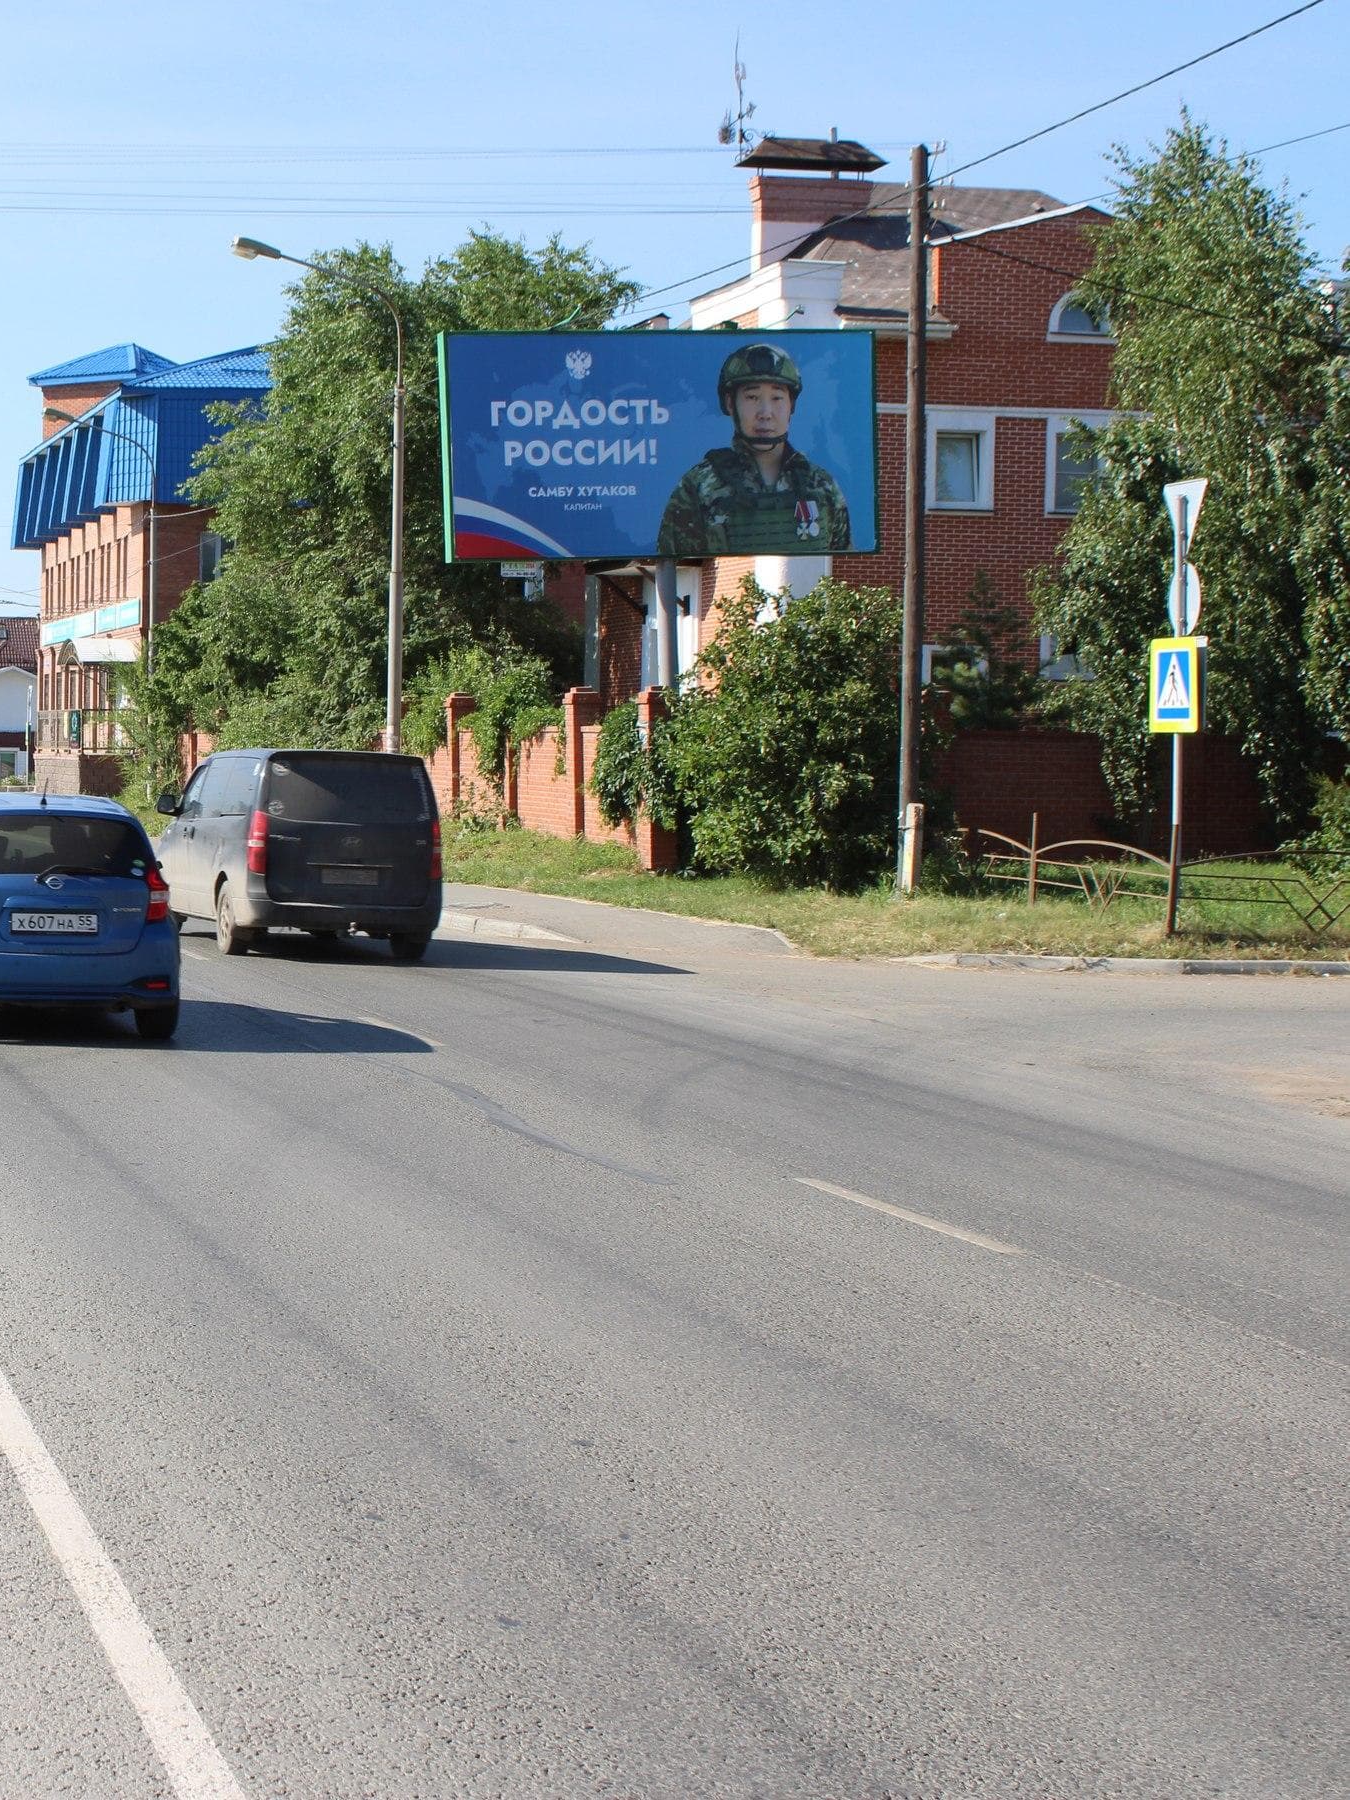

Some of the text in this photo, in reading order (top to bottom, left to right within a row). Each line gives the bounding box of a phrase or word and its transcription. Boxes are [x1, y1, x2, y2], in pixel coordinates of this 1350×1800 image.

[490, 399, 670, 429] ГОРДОСТЬ
[503, 438, 658, 467] РОССИИ!
[528, 485, 637, 498] САМБУ ХУТАКОВ
[564, 502, 602, 512] КАПИТАН
